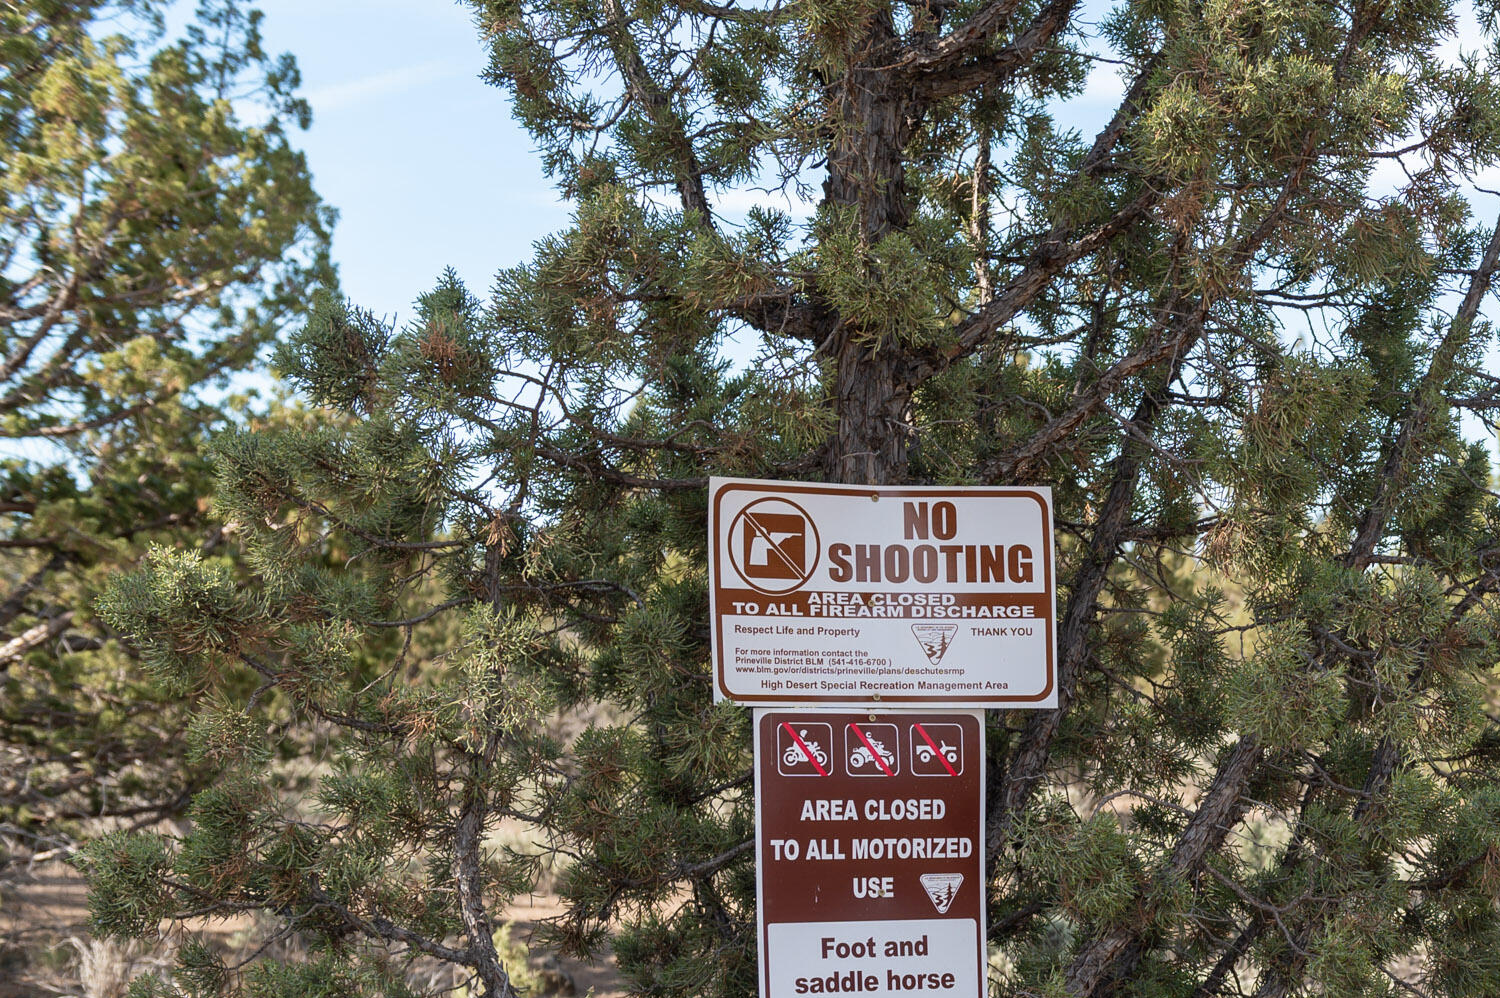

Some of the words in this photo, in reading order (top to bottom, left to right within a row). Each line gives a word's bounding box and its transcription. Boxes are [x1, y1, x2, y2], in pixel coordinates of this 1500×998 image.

[903, 501, 957, 541] NO
[828, 542, 1035, 584] SHOOTING
[807, 592, 865, 605] AREA
[871, 593, 956, 606] CLOSED
[732, 602, 759, 615] TO
[766, 603, 803, 616] ALL
[810, 604, 904, 618] FIREARM
[911, 605, 1035, 618] DISCHARGE
[734, 624, 774, 636] Respect
[776, 625, 794, 635] Life
[796, 626, 814, 635] and
[817, 626, 860, 638] Property
[971, 627, 1008, 636] THANK
[1011, 627, 1033, 636] YOU
[735, 657, 772, 665] Prineville
[774, 657, 803, 665] District
[773, 648, 819, 657] information
[760, 679, 783, 691] High
[785, 680, 818, 690] Desert
[820, 681, 857, 692] Special
[859, 681, 914, 690] Recreation
[917, 681, 983, 692] Management
[985, 681, 1008, 690] Area
[800, 799, 858, 821] AREA
[864, 798, 946, 820] CLOSED
[770, 839, 800, 861] TO
[805, 839, 845, 860] ALL
[852, 837, 972, 860] MOTORIZED
[853, 877, 894, 899] USE
[820, 936, 876, 959] Foot
[884, 935, 929, 957] and
[795, 971, 879, 994] saddle
[887, 969, 955, 991] horse
